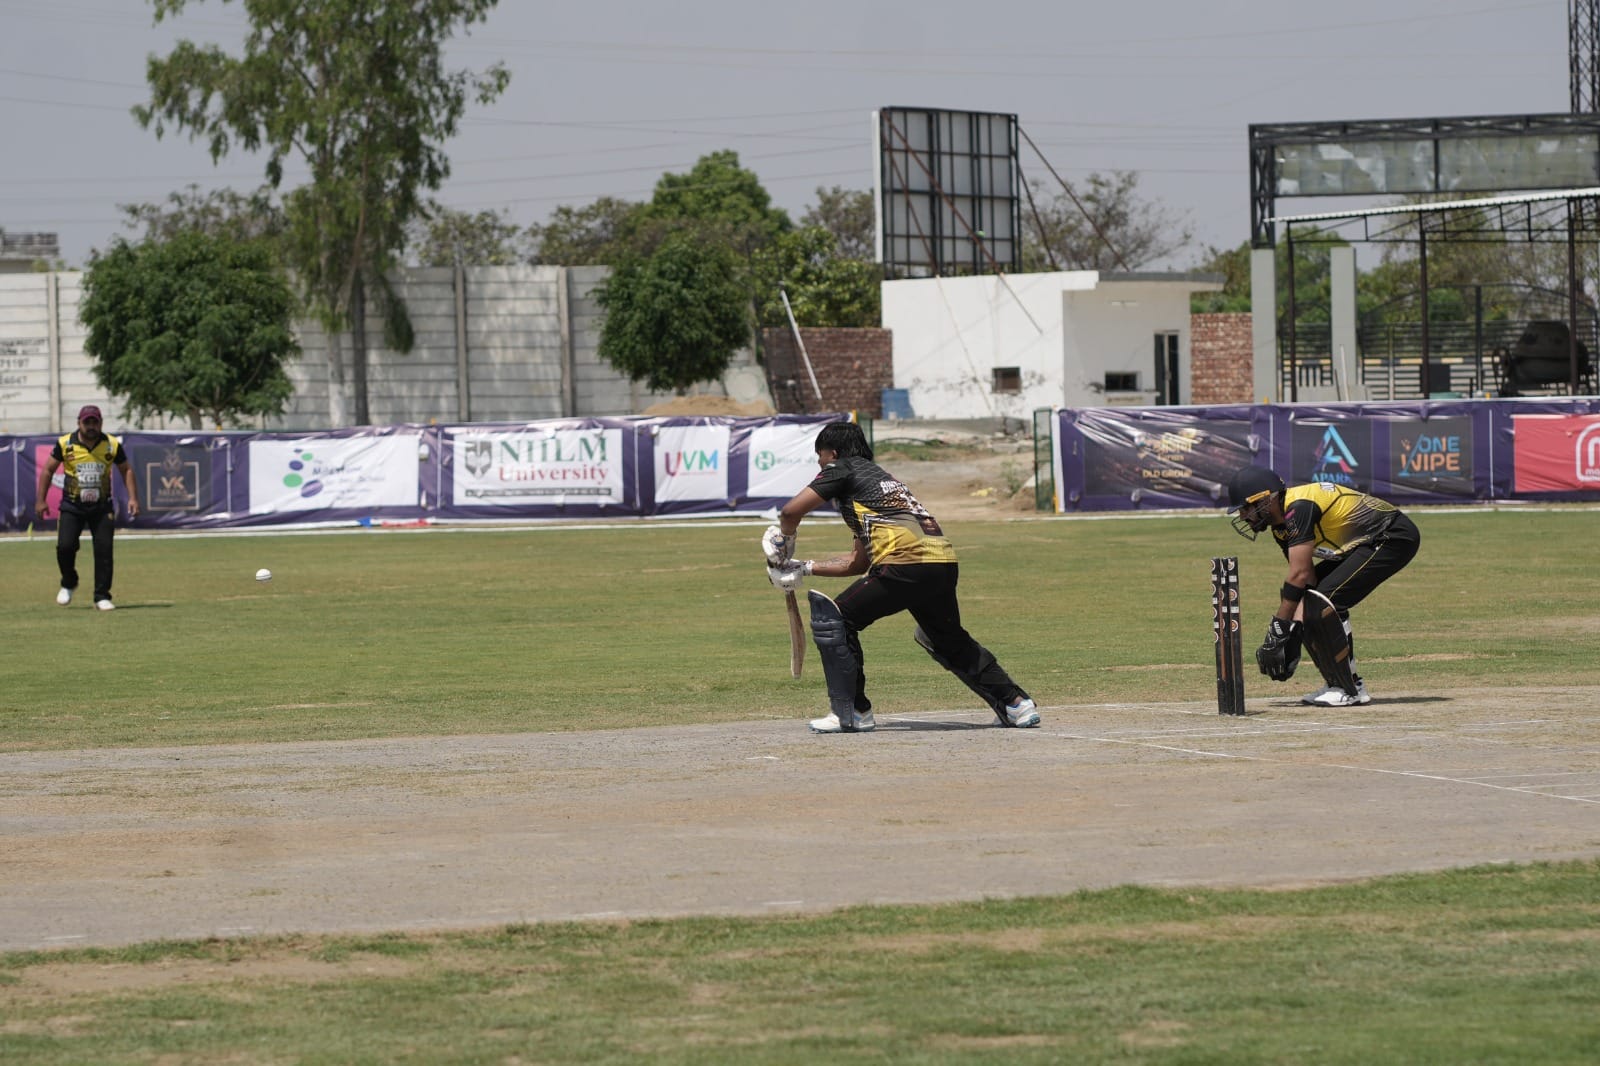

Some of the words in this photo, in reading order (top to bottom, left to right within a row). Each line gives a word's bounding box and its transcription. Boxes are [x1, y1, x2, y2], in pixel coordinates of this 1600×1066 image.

[1418, 435, 1460, 452] ONE
[665, 449, 718, 477] UVM
[1400, 452, 1461, 471] WIPE
[161, 476, 184, 489] VK
[499, 464, 609, 485] University
